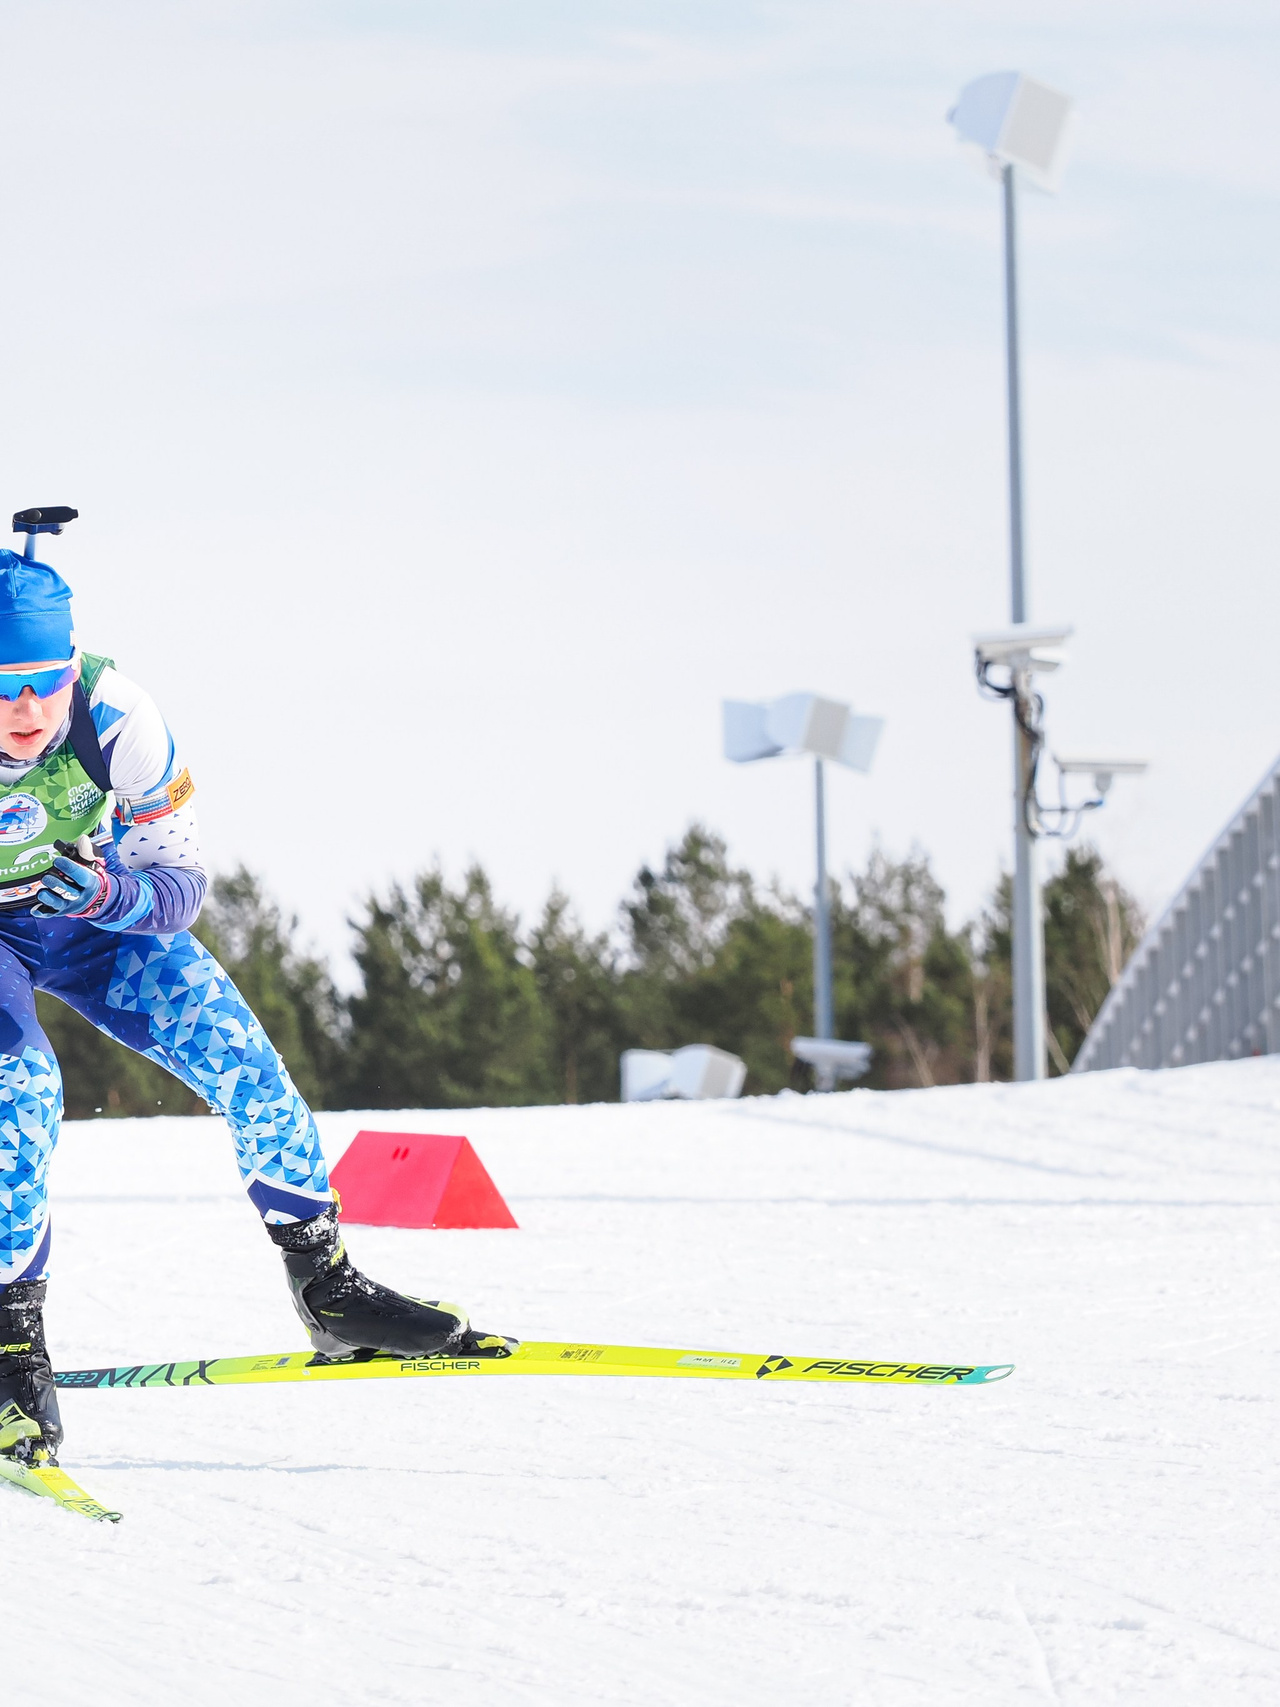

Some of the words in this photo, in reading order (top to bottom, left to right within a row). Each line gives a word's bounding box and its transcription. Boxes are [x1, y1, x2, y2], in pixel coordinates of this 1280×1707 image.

[67, 781, 93, 797] СПОР
[400, 1360, 481, 1372] FISCHER
[801, 1360, 974, 1381] FISCHER
[53, 1371, 99, 1384] PEED
